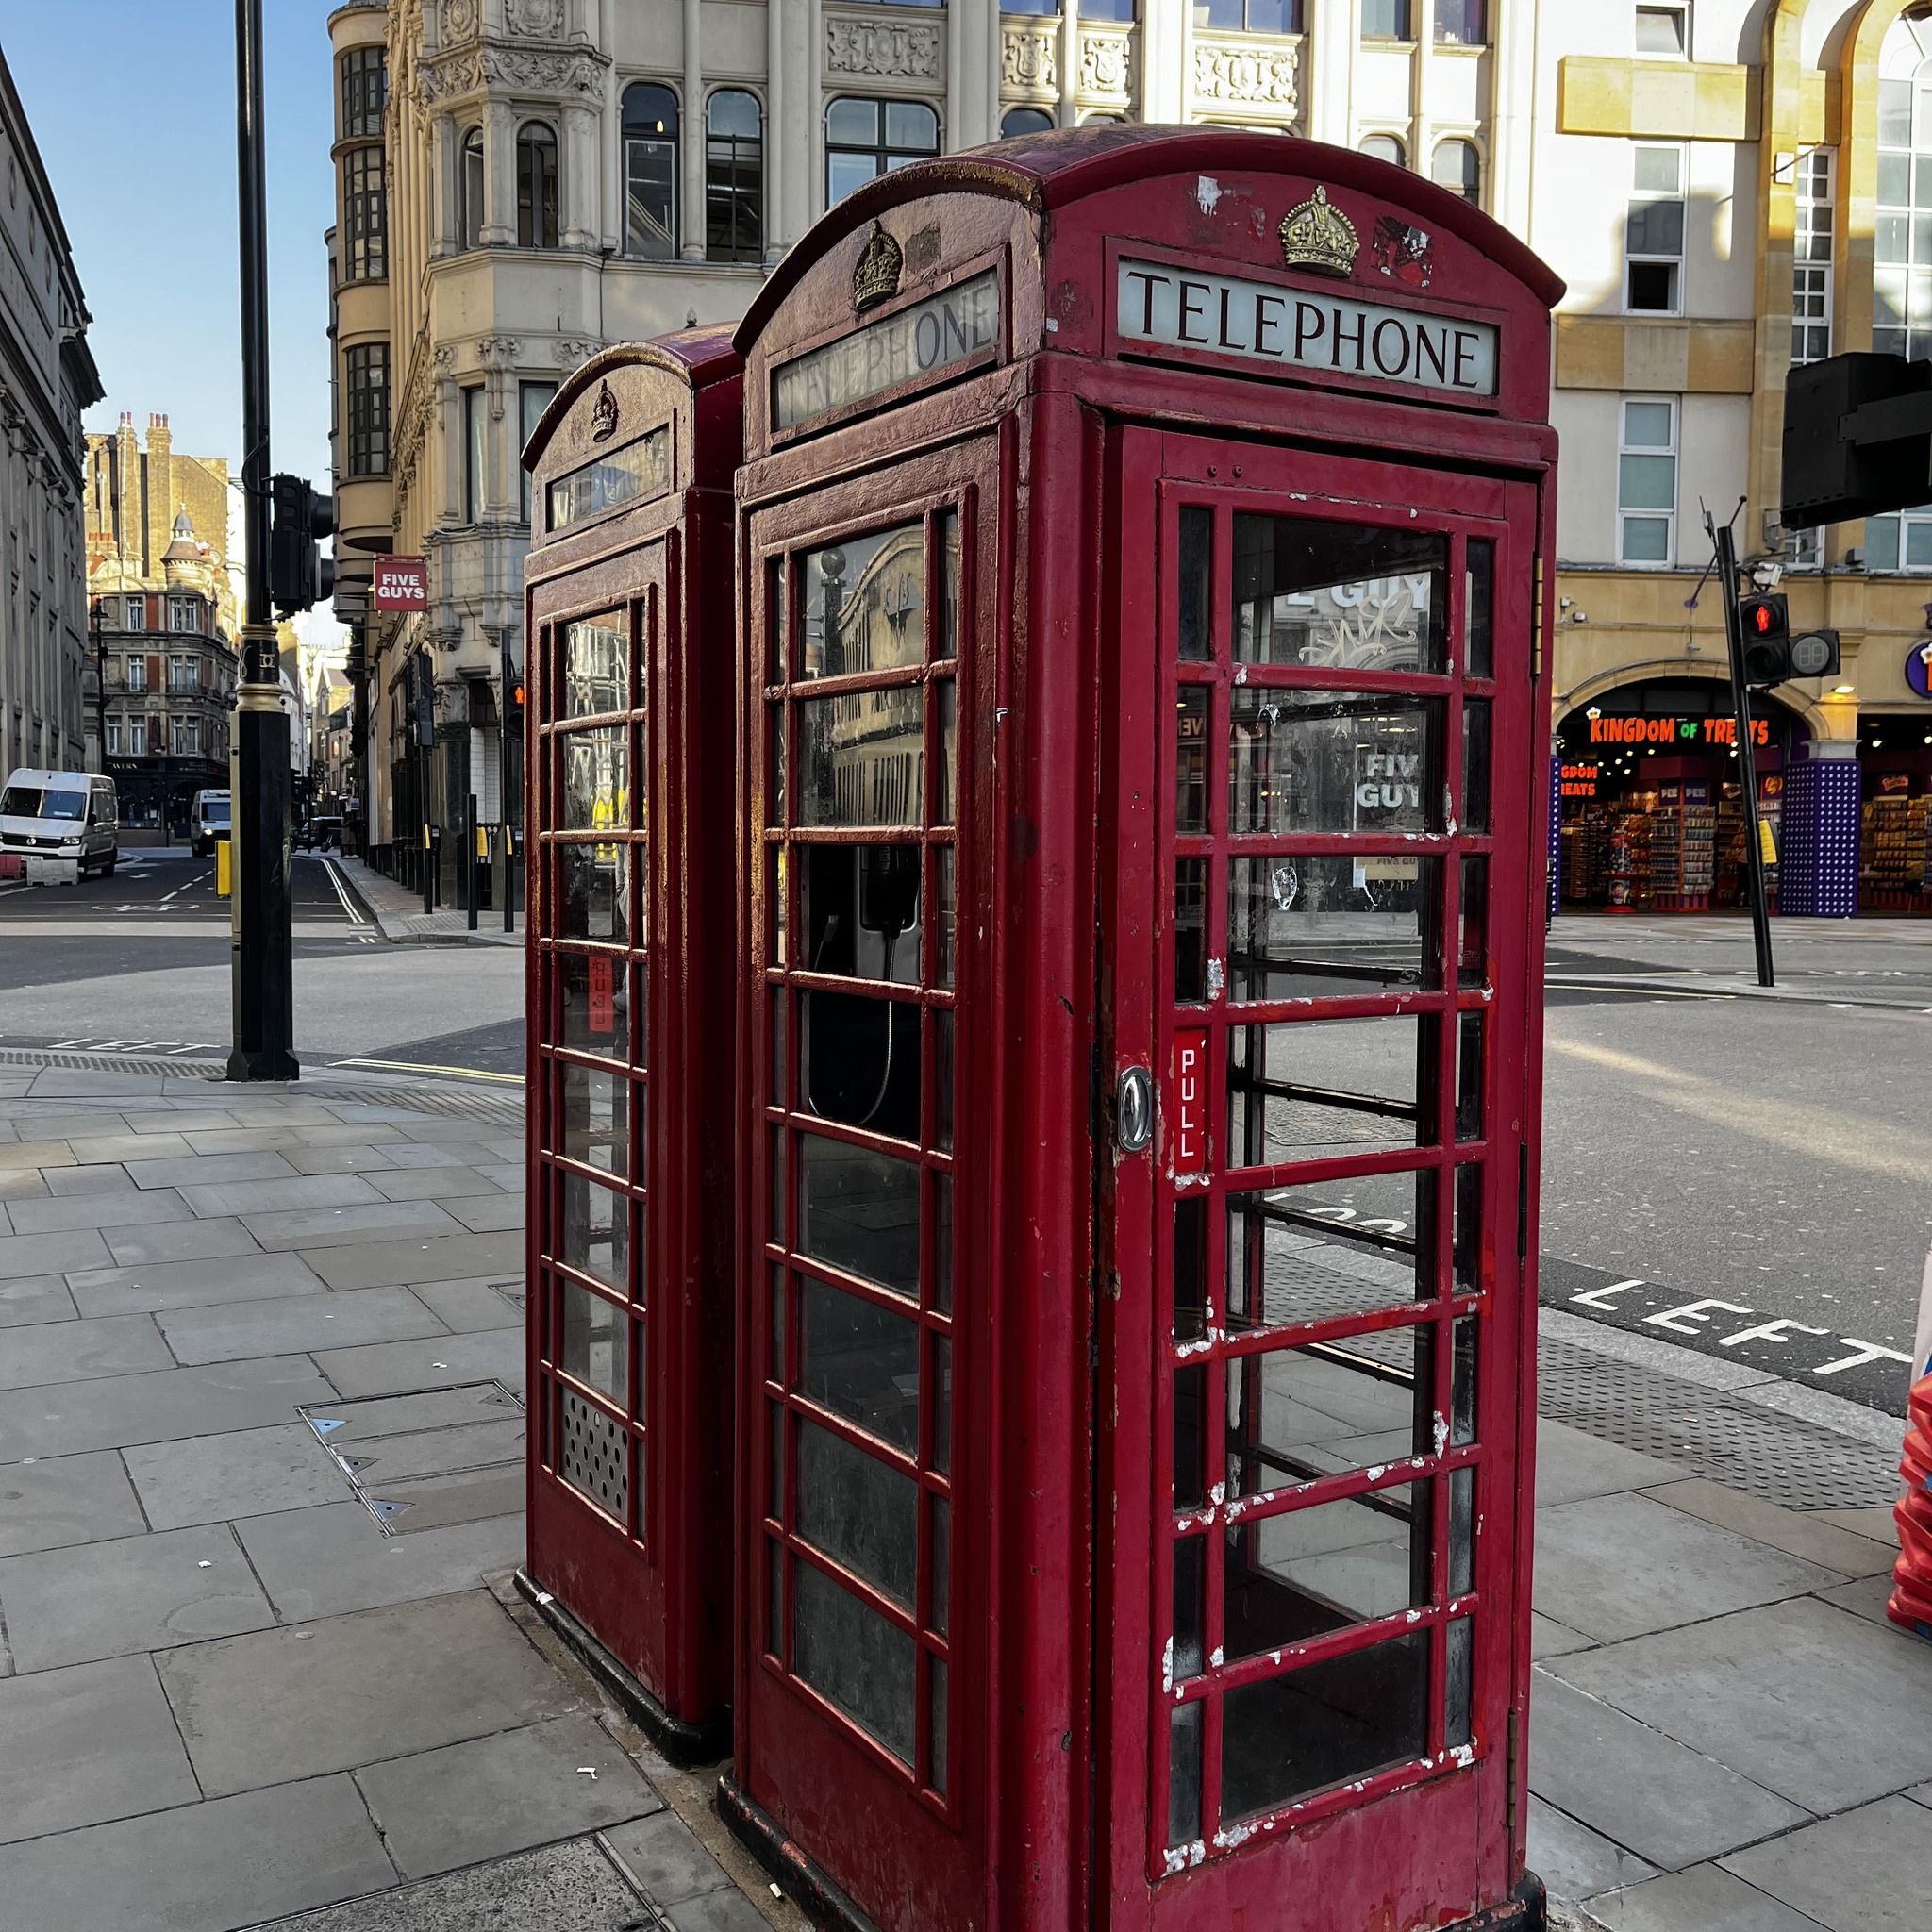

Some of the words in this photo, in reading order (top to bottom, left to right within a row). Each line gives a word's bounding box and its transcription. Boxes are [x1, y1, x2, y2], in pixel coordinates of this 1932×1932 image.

[1127, 271, 1480, 388] TELEPHONE
[378, 586, 425, 599] GUYS
[382, 574, 420, 586] FIVE
[1591, 718, 1675, 743] KINGDOM
[1680, 723, 1698, 739] OF
[1704, 719, 1769, 744] TRETS
[47, 1039, 222, 1054] LEFT
[1181, 1049, 1195, 1157] PULL
[1568, 1279, 1915, 1374] LEFT
